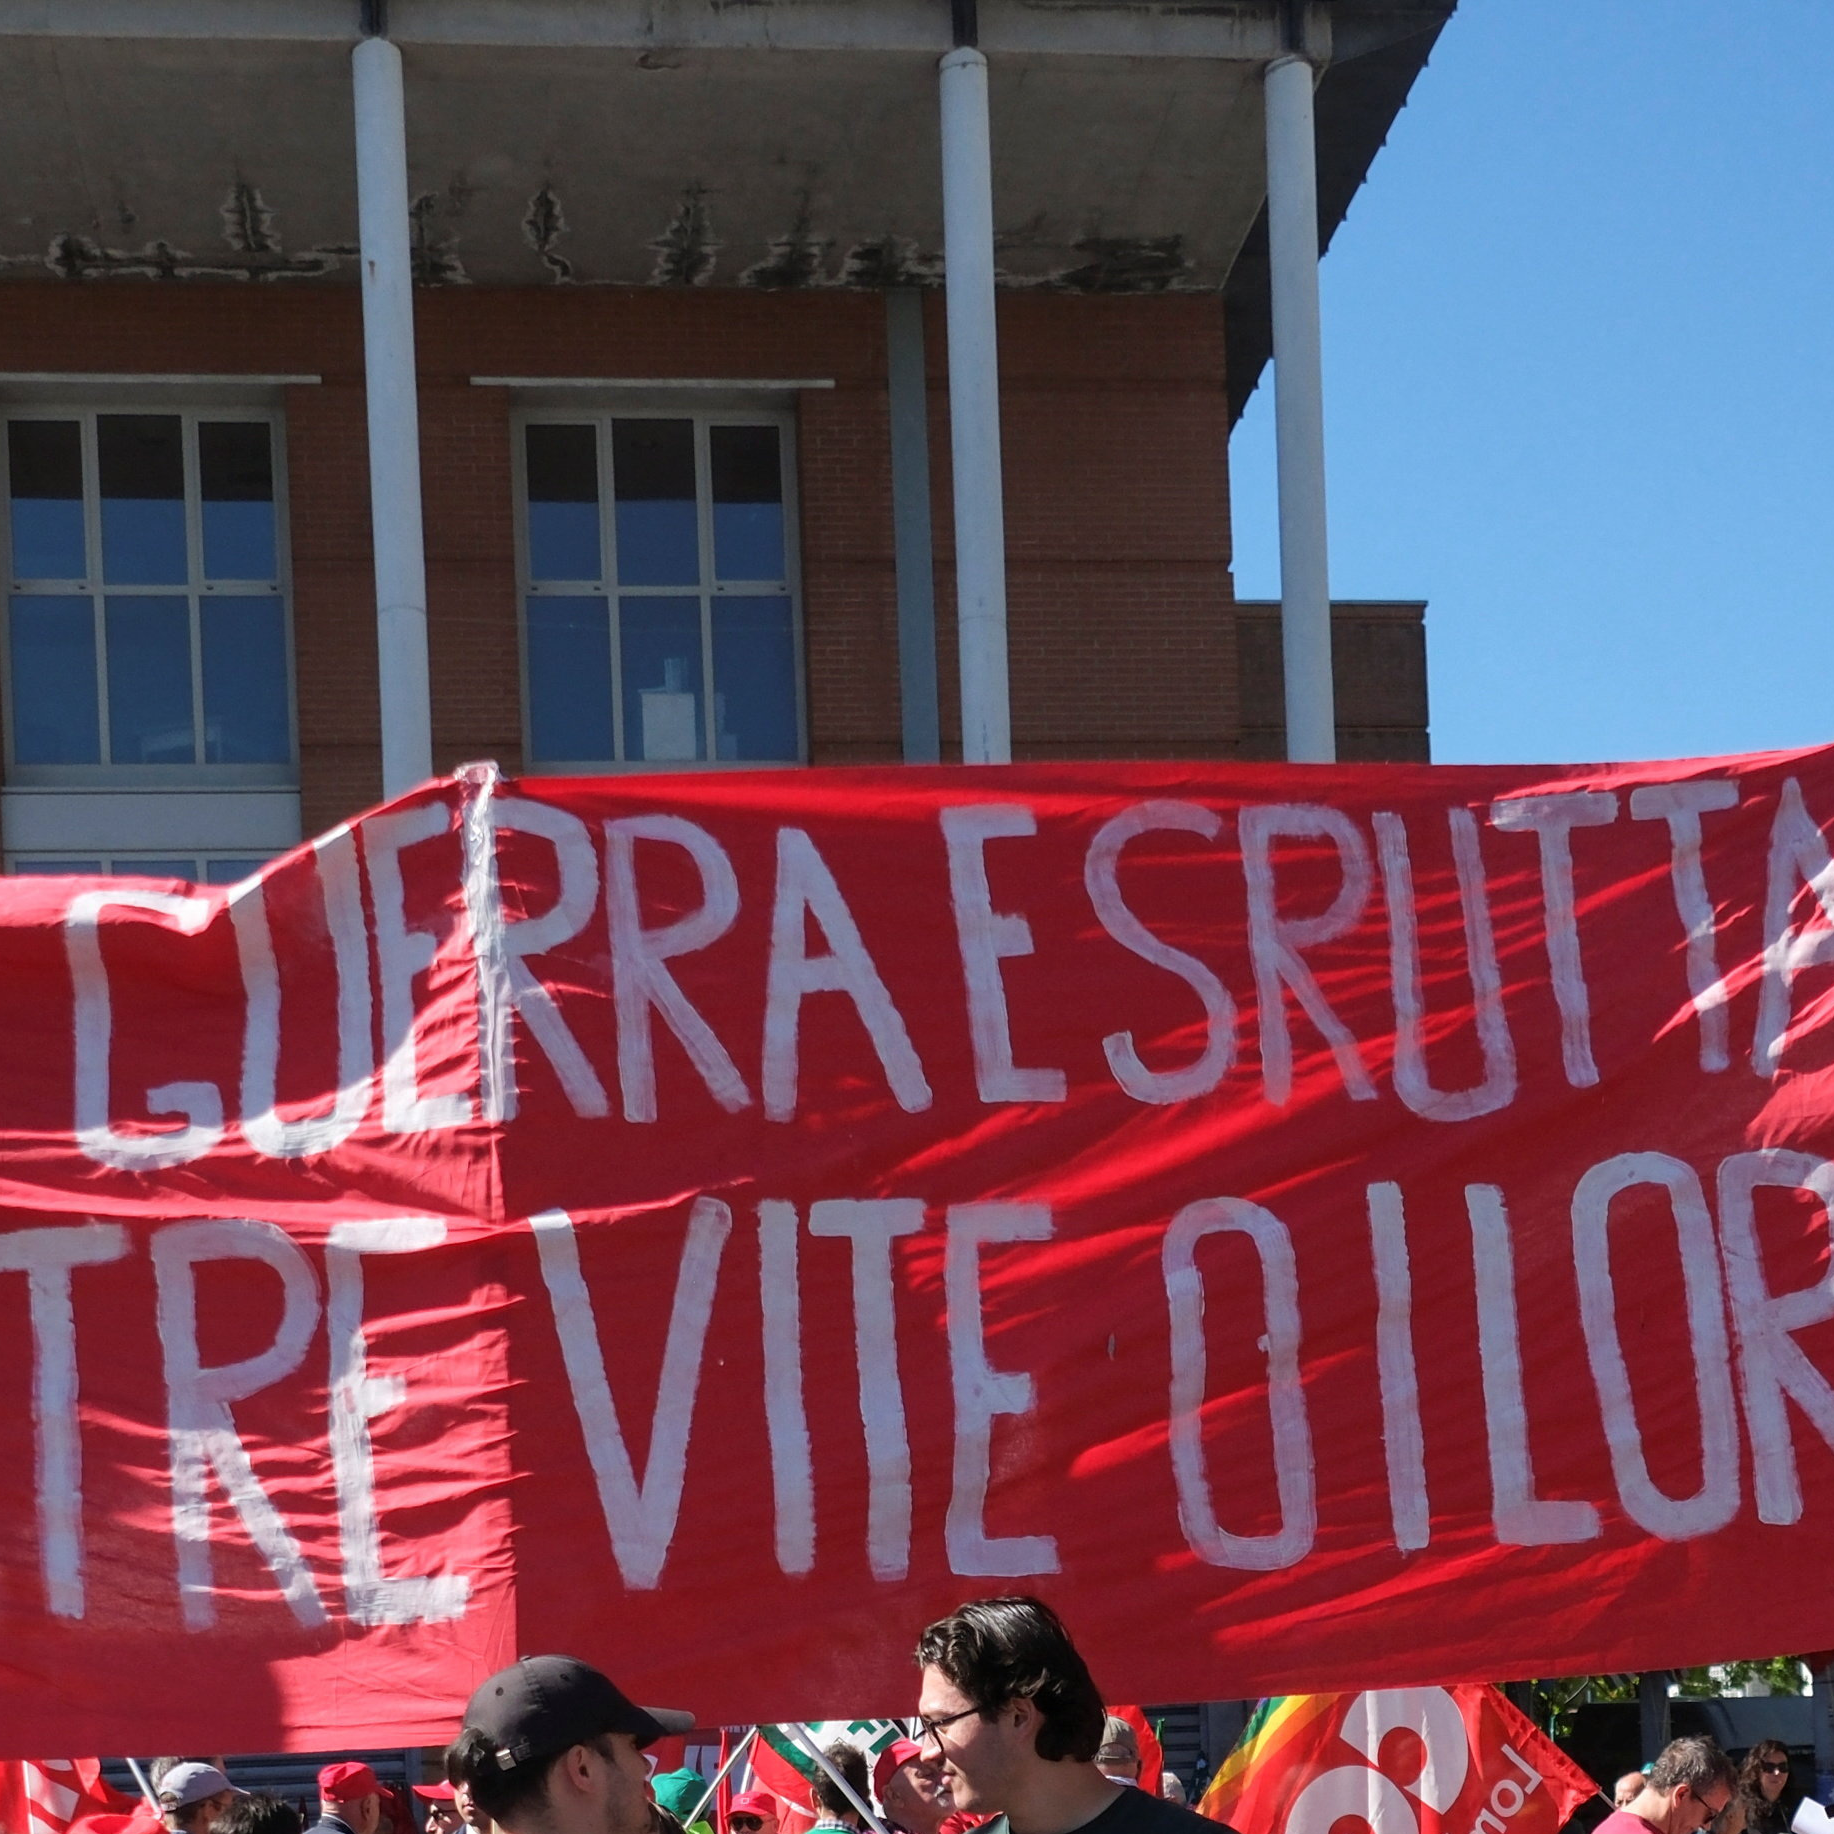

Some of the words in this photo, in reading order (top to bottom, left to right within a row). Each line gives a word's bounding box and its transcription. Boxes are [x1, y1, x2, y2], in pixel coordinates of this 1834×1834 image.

[64, 797, 933, 1172] GUERRA
[939, 804, 1067, 1105] E
[528, 1196, 1061, 1590] VITE
[1161, 1196, 1315, 1571] O
